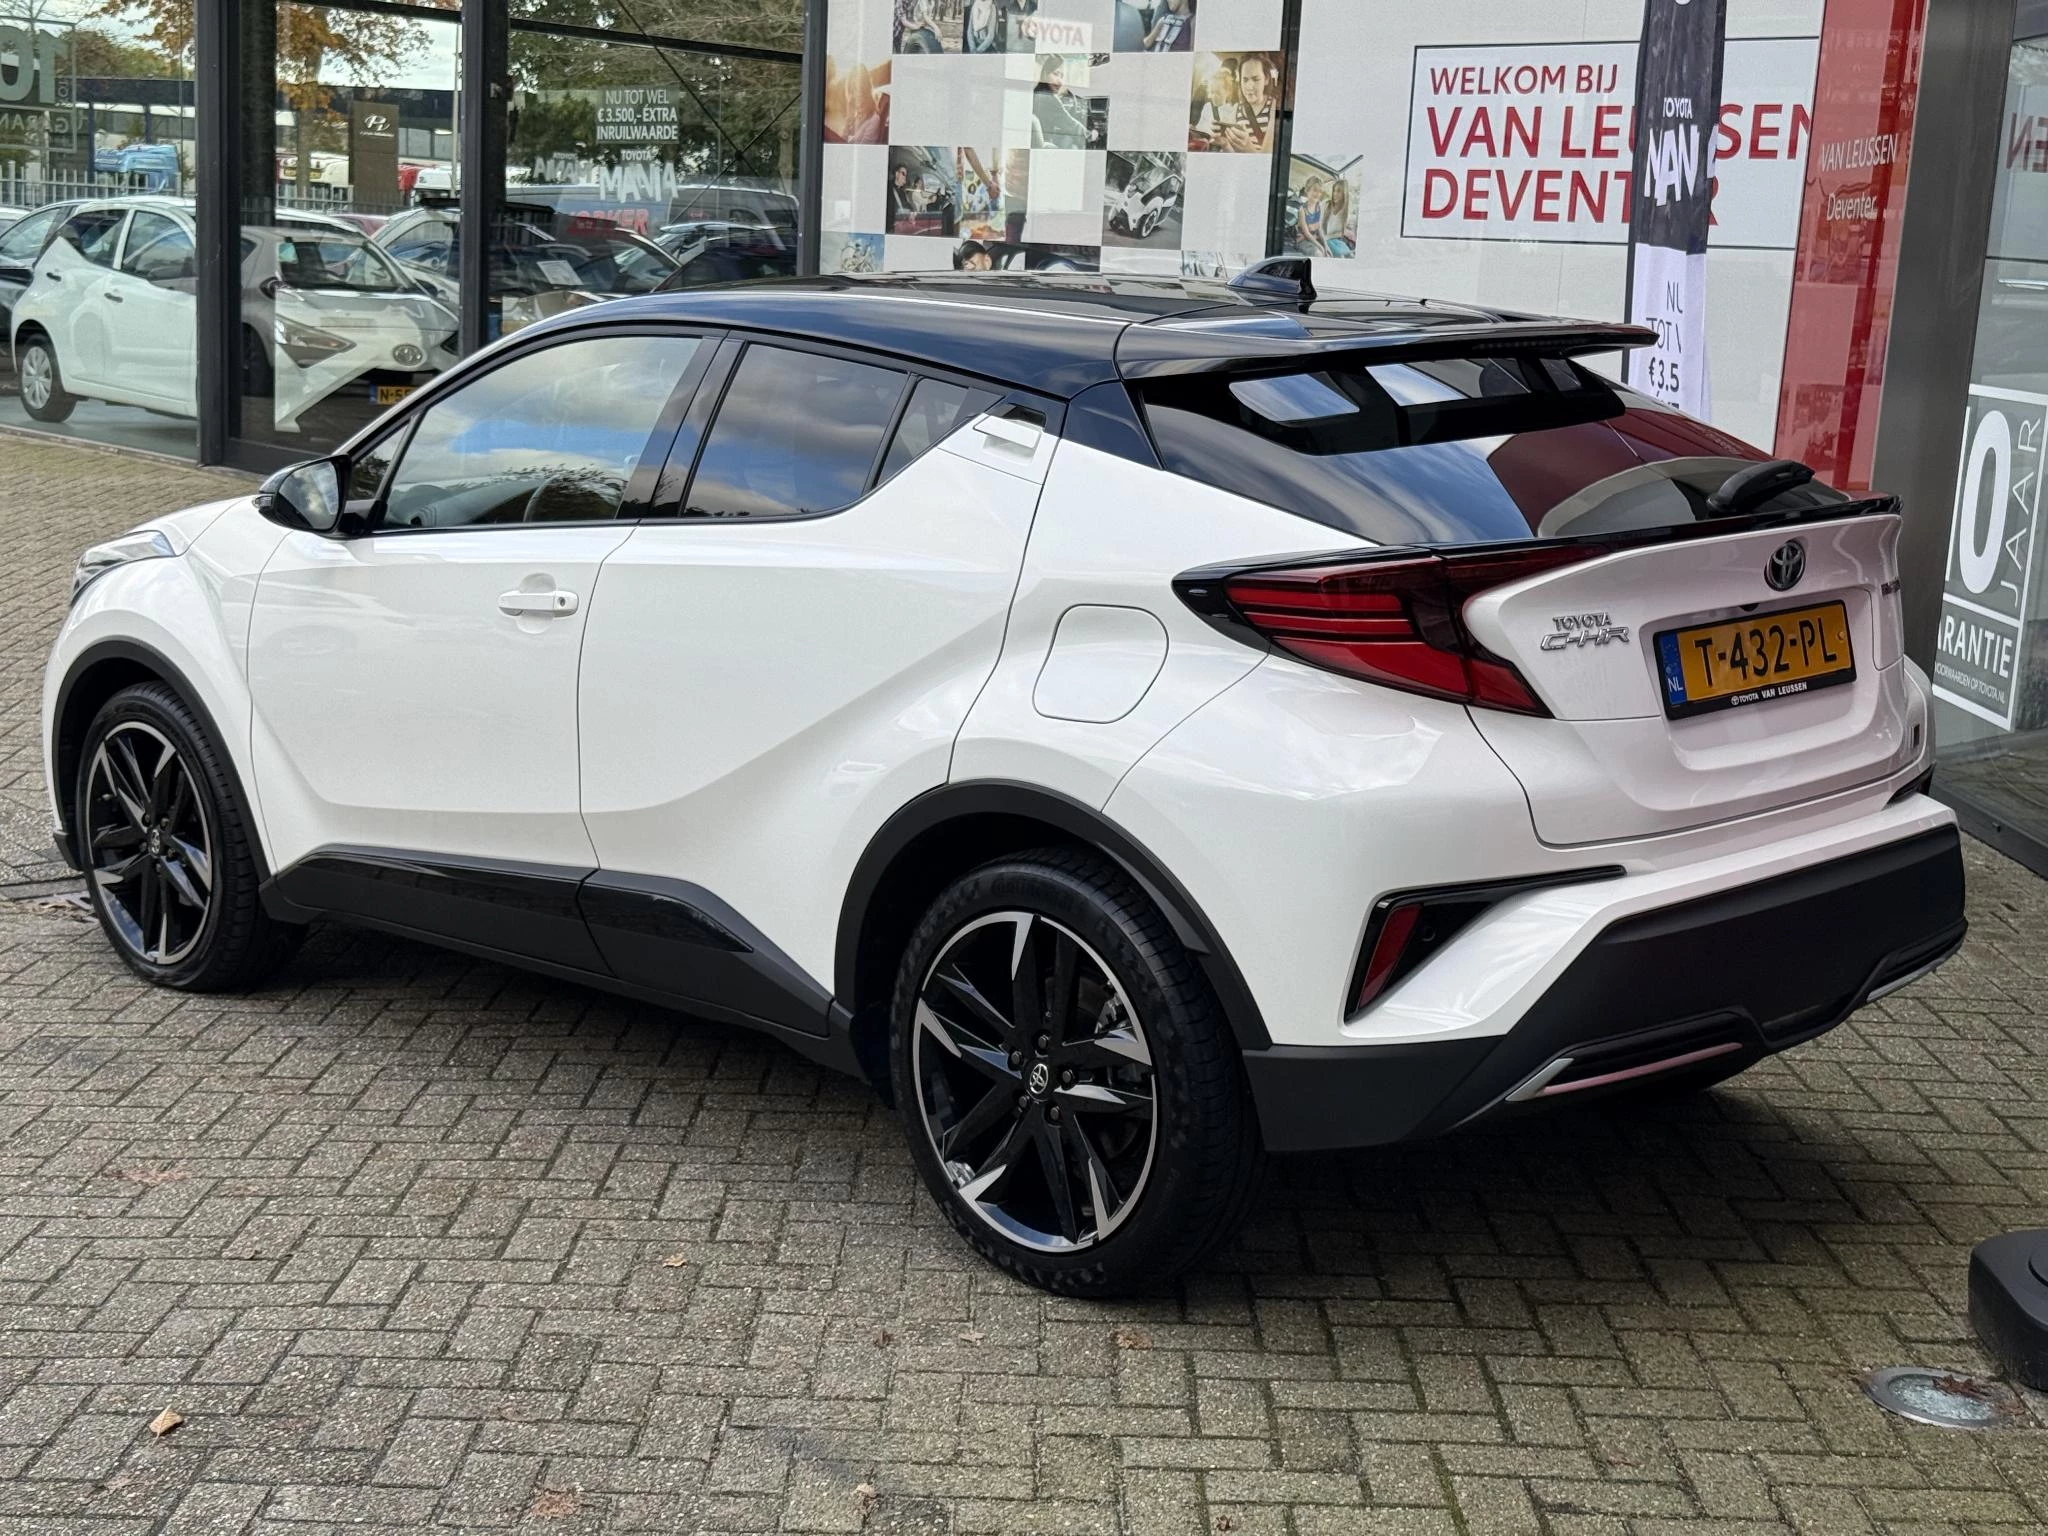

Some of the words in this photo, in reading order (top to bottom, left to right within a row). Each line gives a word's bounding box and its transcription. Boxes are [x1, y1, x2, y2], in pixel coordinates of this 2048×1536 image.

[1430, 65, 1566, 95] WELKOM
[1575, 64, 1618, 94] BIJ
[605, 90, 622, 104] NU
[624, 90, 644, 104] TOT
[646, 89, 670, 104] WEL
[597, 125, 679, 140] INRUILWAARDE
[1427, 106, 1543, 158] VAN
[1560, 104, 1811, 160] LESEN
[620, 149, 653, 161] TOYOTA
[1820, 141, 1847, 172] VAN
[1846, 133, 1899, 169] LEUSSEN
[600, 162, 679, 203] MANIA
[1422, 169, 1719, 225] DEVENT
[1827, 193, 1877, 221] Deventer
[1646, 317, 1672, 351] TOT
[2000, 418, 2041, 608] JAAR
[1553, 612, 1612, 631] TOYOTA
[1541, 627, 1630, 651] C-HR
[1694, 617, 1837, 687] T-432-PL
[1668, 677, 1683, 692] NL
[1740, 694, 1759, 703] TOYOTA
[1761, 688, 1776, 699] VAN
[1778, 681, 1808, 696] LEUSSEN
